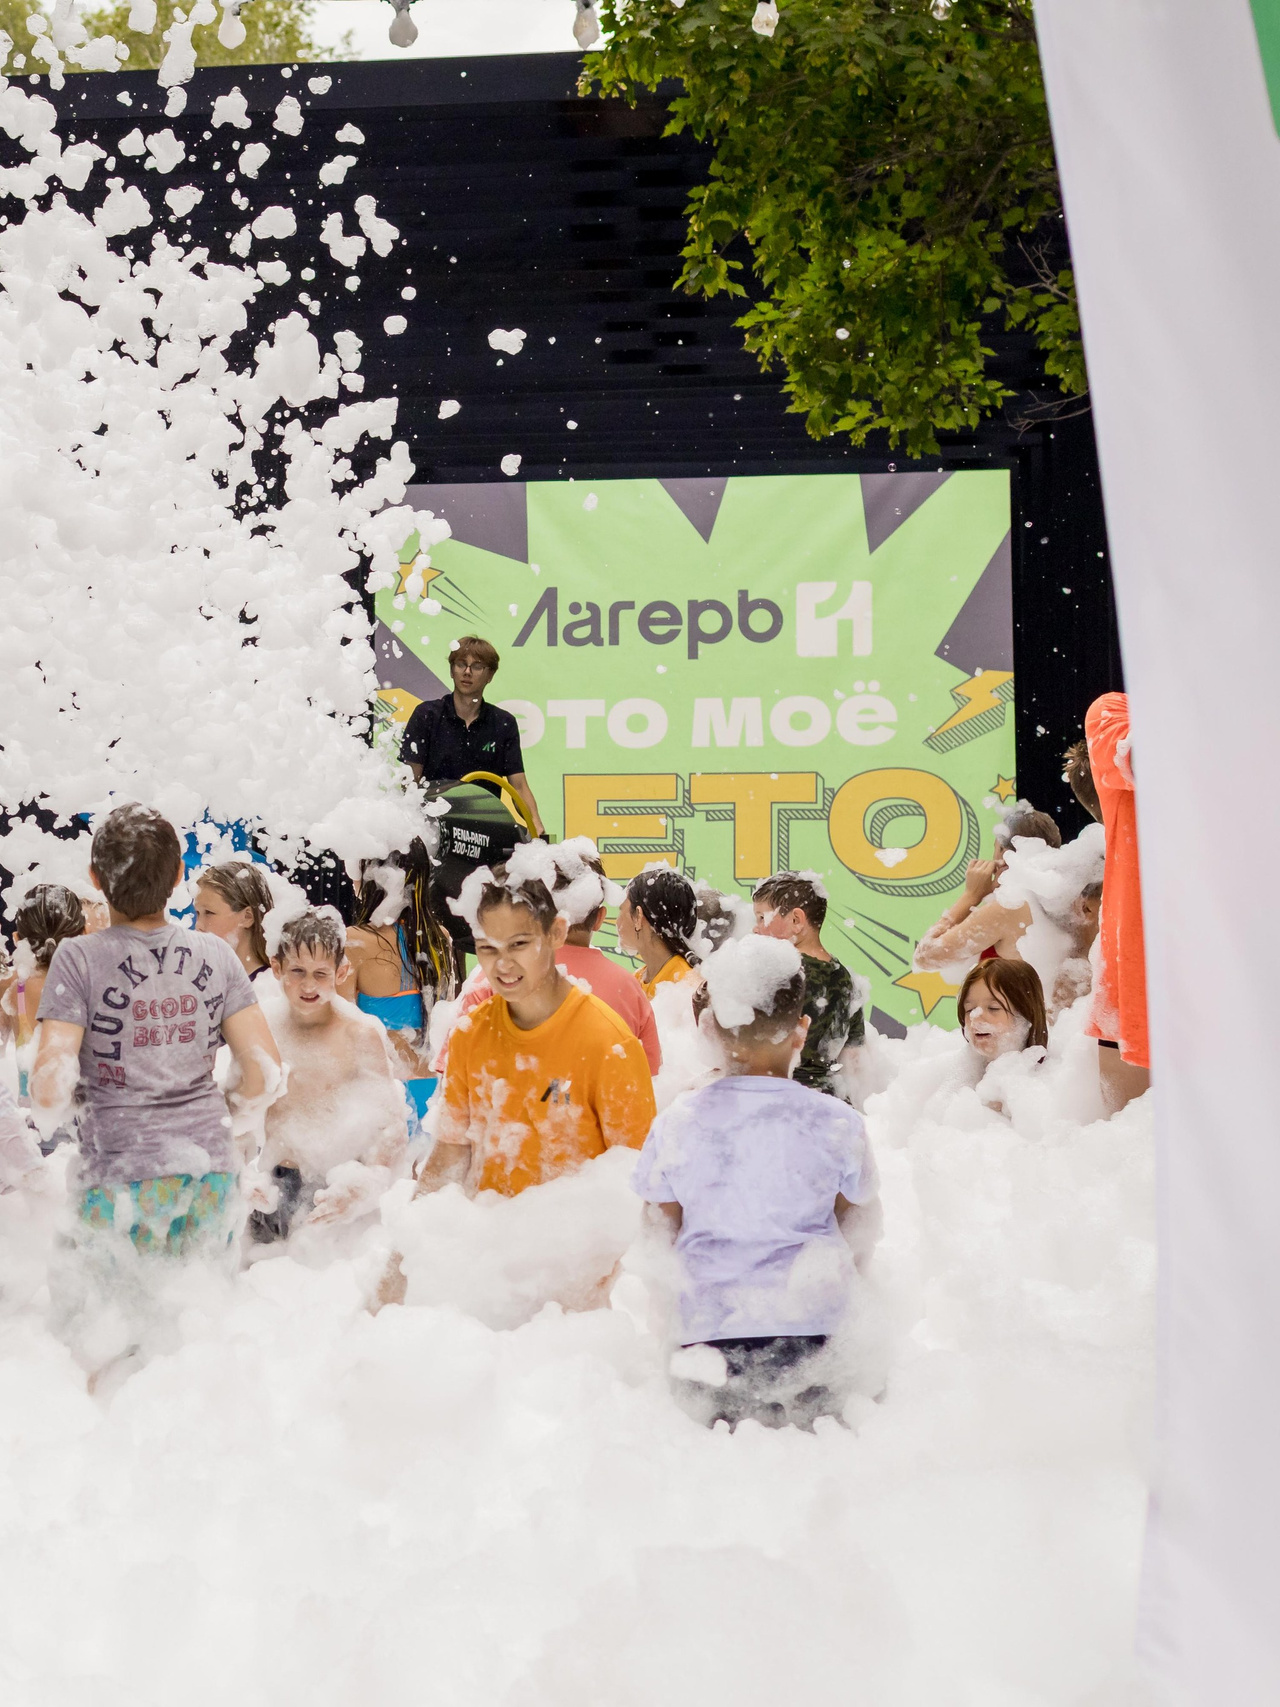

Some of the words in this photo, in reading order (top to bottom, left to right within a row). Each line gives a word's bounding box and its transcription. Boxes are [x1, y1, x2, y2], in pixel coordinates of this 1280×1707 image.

[511, 586, 784, 660] Лагерь
[562, 767, 981, 897] ЕТО
[132, 994, 198, 1021] GOOD
[133, 1020, 197, 1048] BOYS
